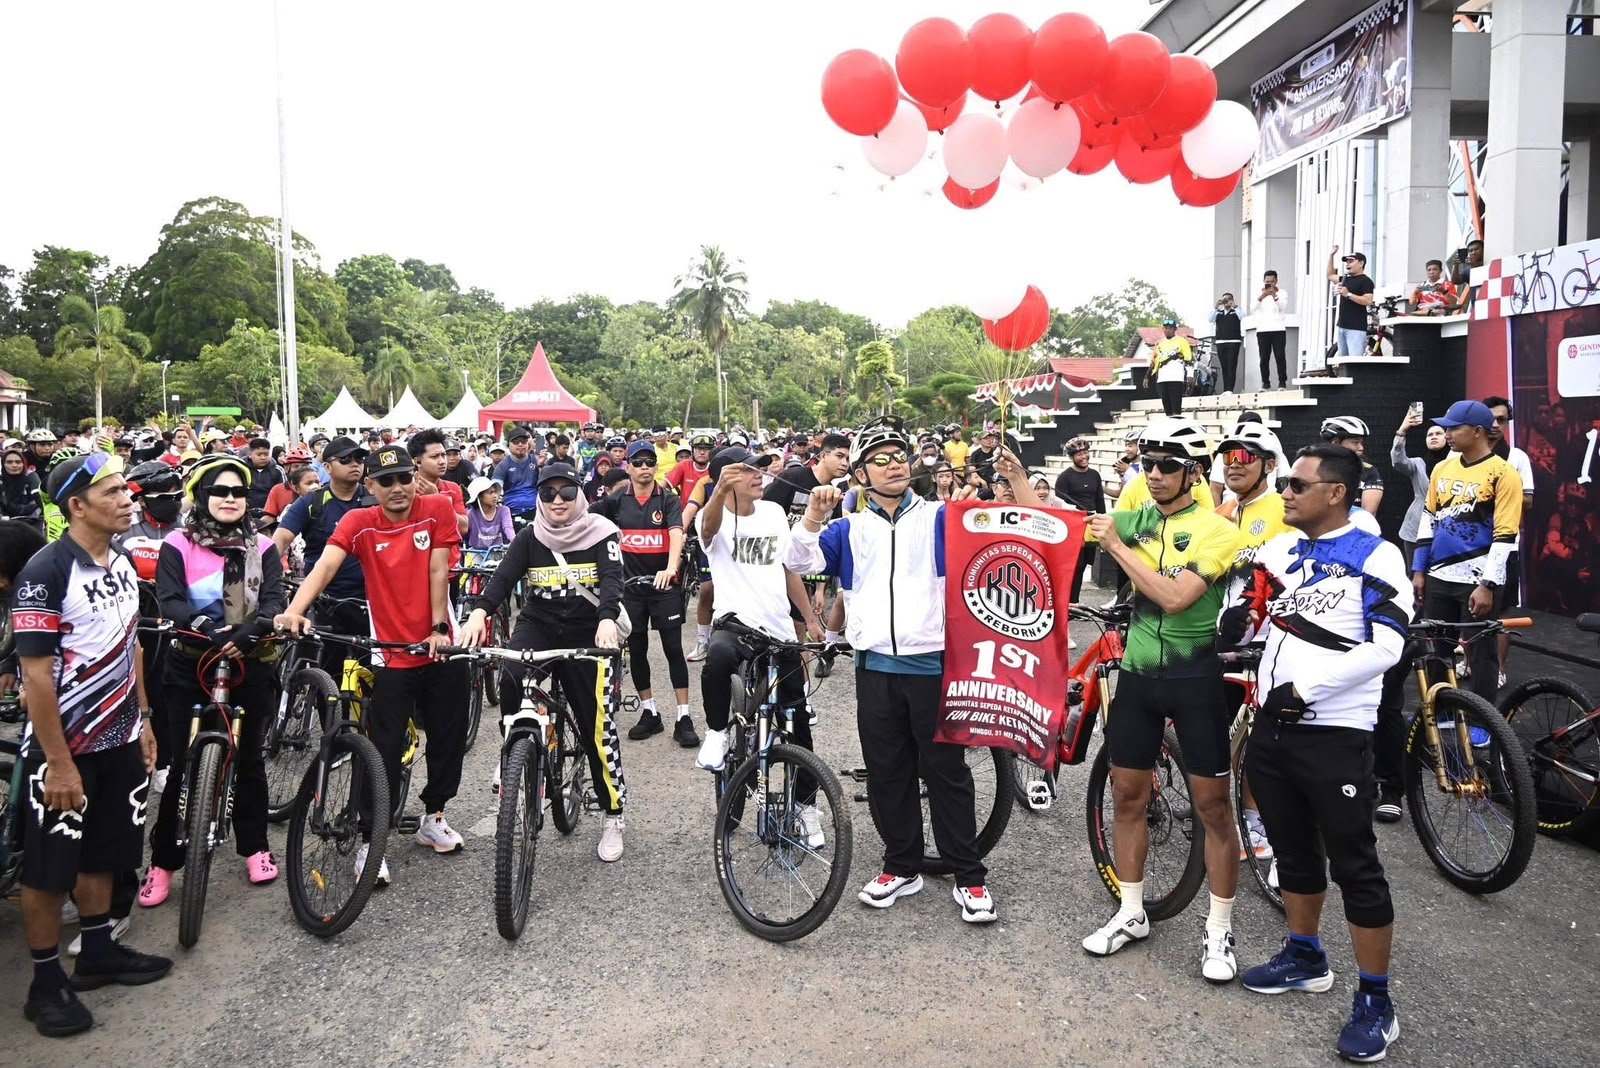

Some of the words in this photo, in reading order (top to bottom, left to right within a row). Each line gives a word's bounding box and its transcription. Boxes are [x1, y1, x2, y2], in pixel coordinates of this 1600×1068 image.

[1577, 428, 1600, 484] 1
[1438, 478, 1480, 498] KSK
[83, 570, 136, 604] KSK
[967, 545, 1000, 587] KOMUNITAS
[1001, 544, 1033, 562] SEPEDA
[1033, 559, 1054, 607] KETAPANG
[985, 560, 1039, 619] KSK
[14, 614, 48, 629] KSK
[983, 614, 1037, 638] REBORN
[970, 640, 1041, 680] 1ST
[945, 700, 979, 708] KOMUNITAS
[980, 702, 1002, 712] SEPEDA
[1003, 705, 1030, 723] KETAPANG
[946, 681, 1053, 726] ANNIVERSARY
[946, 710, 970, 720] FUN
[970, 711, 997, 724] BIKE
[999, 714, 1046, 749] KETAPANG
